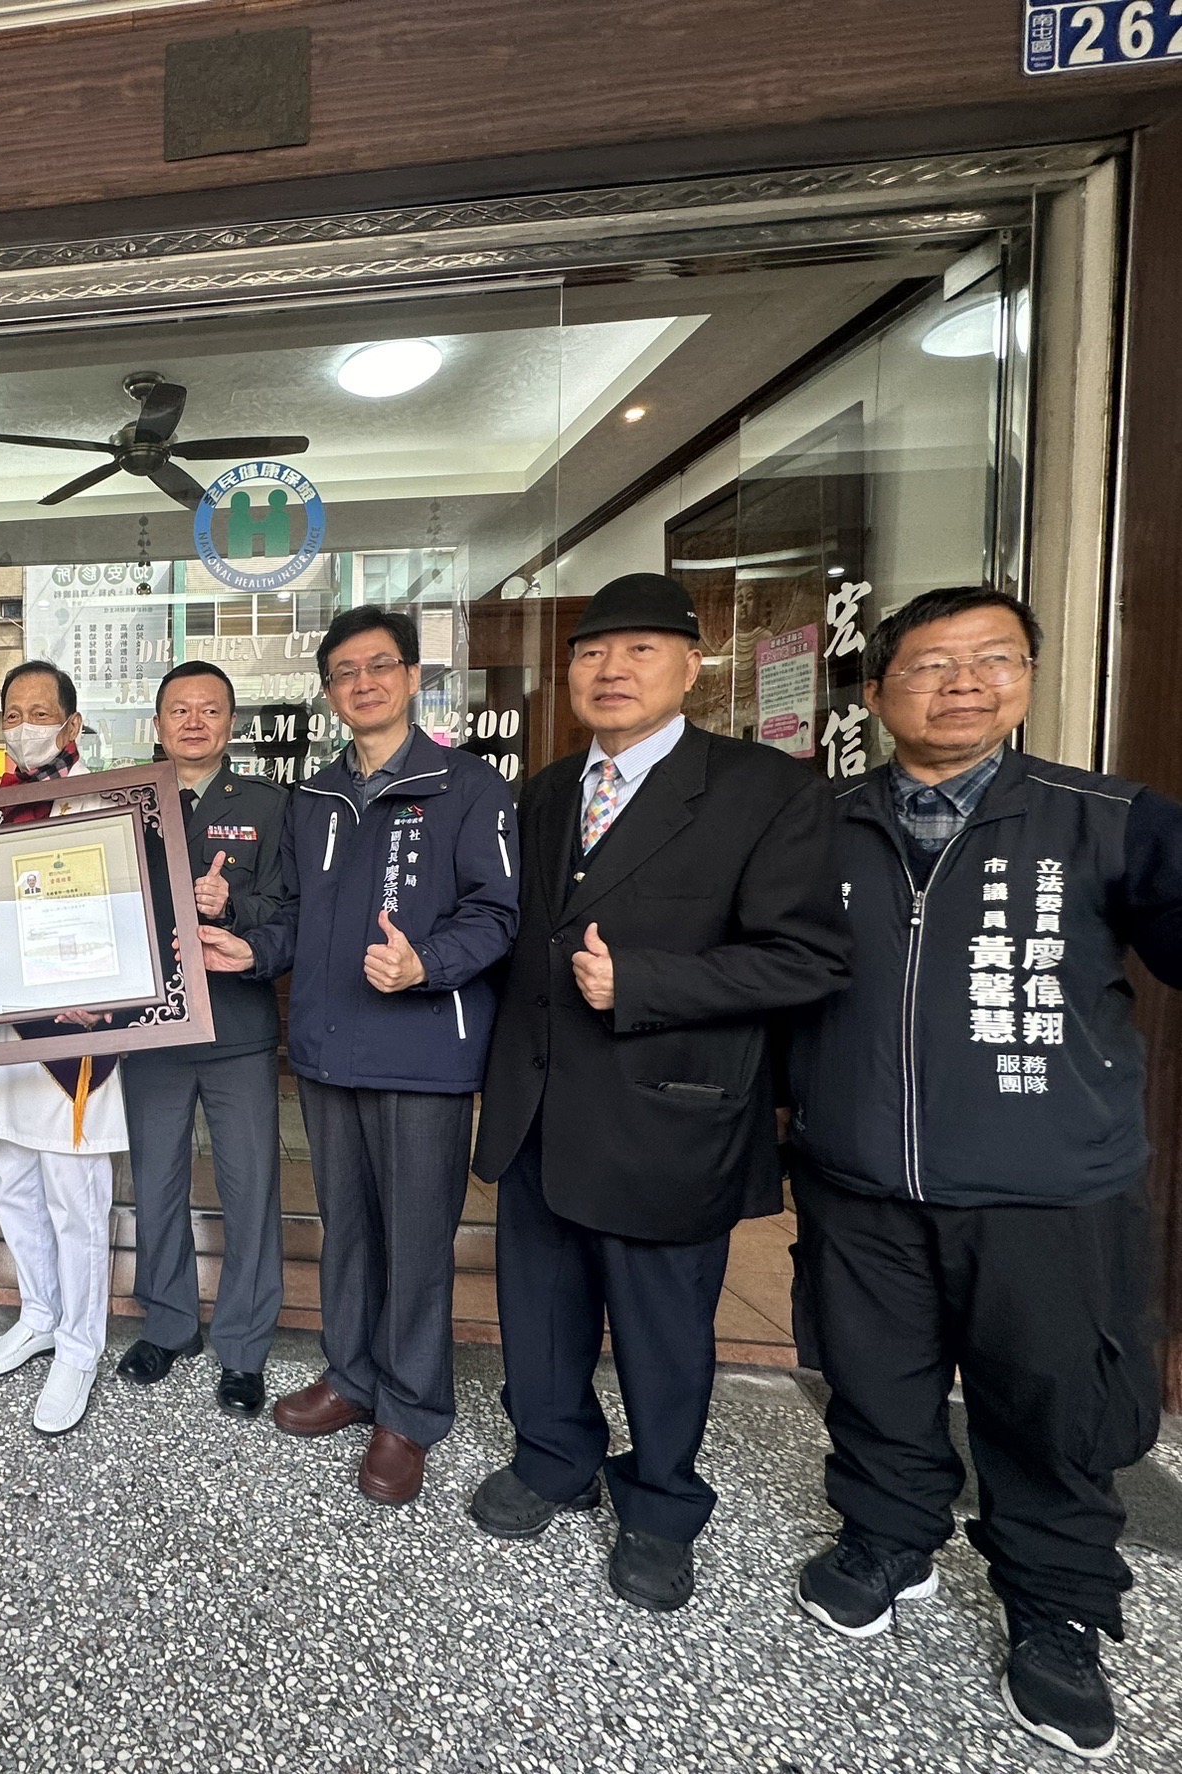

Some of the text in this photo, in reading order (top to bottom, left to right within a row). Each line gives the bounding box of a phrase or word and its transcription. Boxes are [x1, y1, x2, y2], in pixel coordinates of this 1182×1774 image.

[1031, 13, 1054, 54] 南屯區
[203, 462, 316, 509] 全民健康保險
[198, 526, 321, 588] NATIONAL HEALTH INSURANCE
[137, 638, 179, 663] DR.
[197, 636, 267, 661] CHEN
[820, 581, 872, 779] 宏信
[239, 714, 297, 743] AM
[422, 709, 520, 739] 12:00
[404, 828, 421, 888] 社會局
[996, 1054, 1048, 1074] 服務
[998, 1074, 1049, 1094] 團隊
